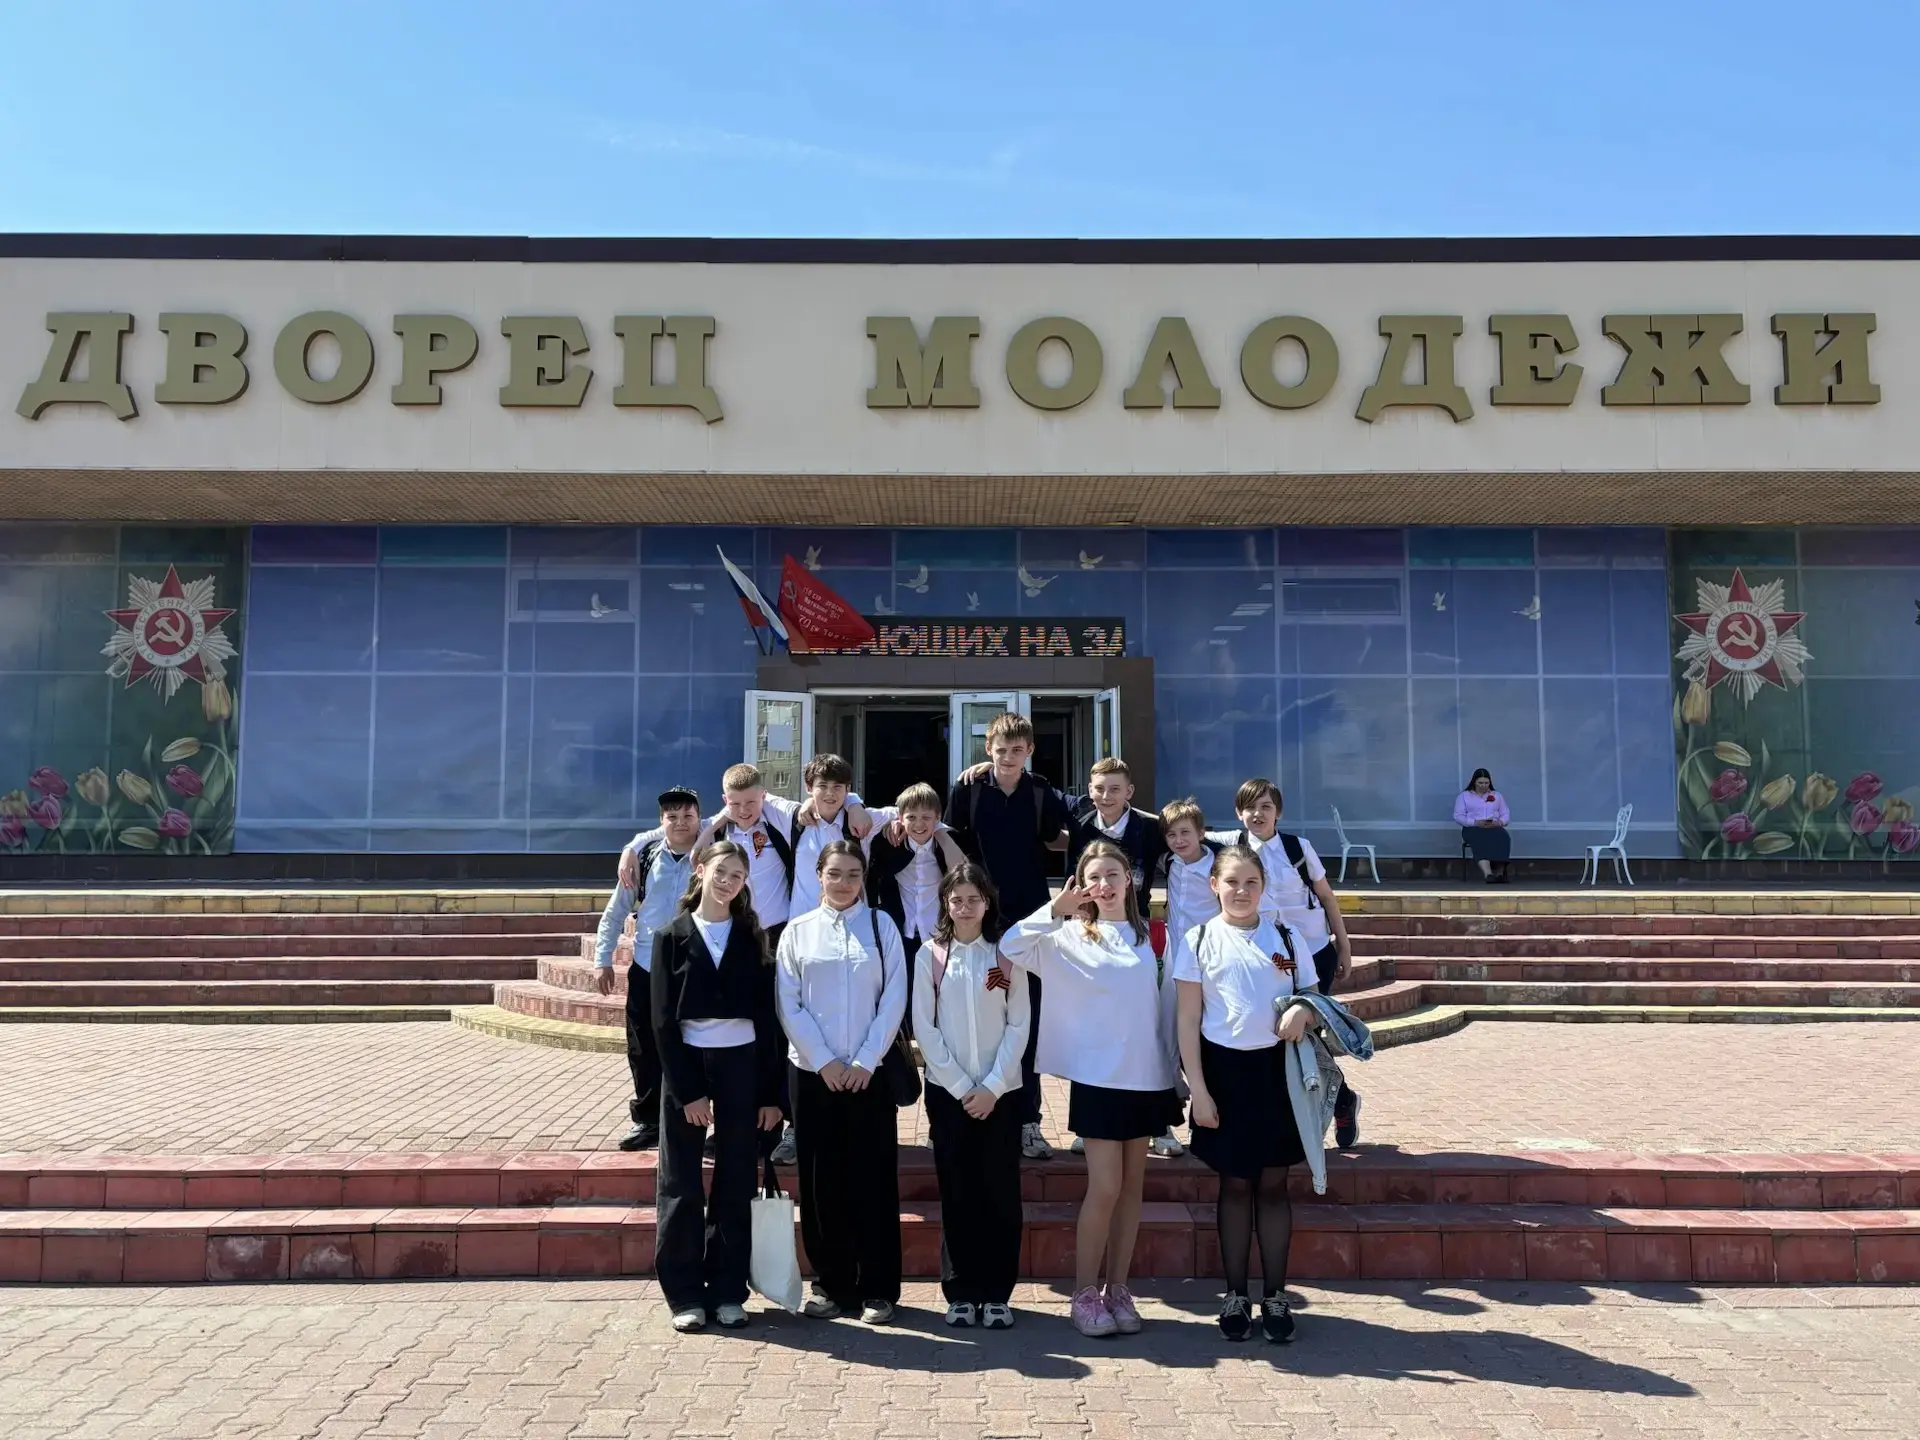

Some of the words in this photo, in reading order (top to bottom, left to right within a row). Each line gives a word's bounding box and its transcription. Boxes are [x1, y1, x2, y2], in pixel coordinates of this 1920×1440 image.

[15, 311, 725, 424] ДВОРЕЦ
[865, 312, 1881, 423] МОЛОДЕЖИ
[135, 599, 198, 660] ОТЕЧЕСТВЕННАЯ
[1020, 626, 1075, 655] НА
[1707, 603, 1768, 665] ОТЕЧЕСТВЕННАЯ
